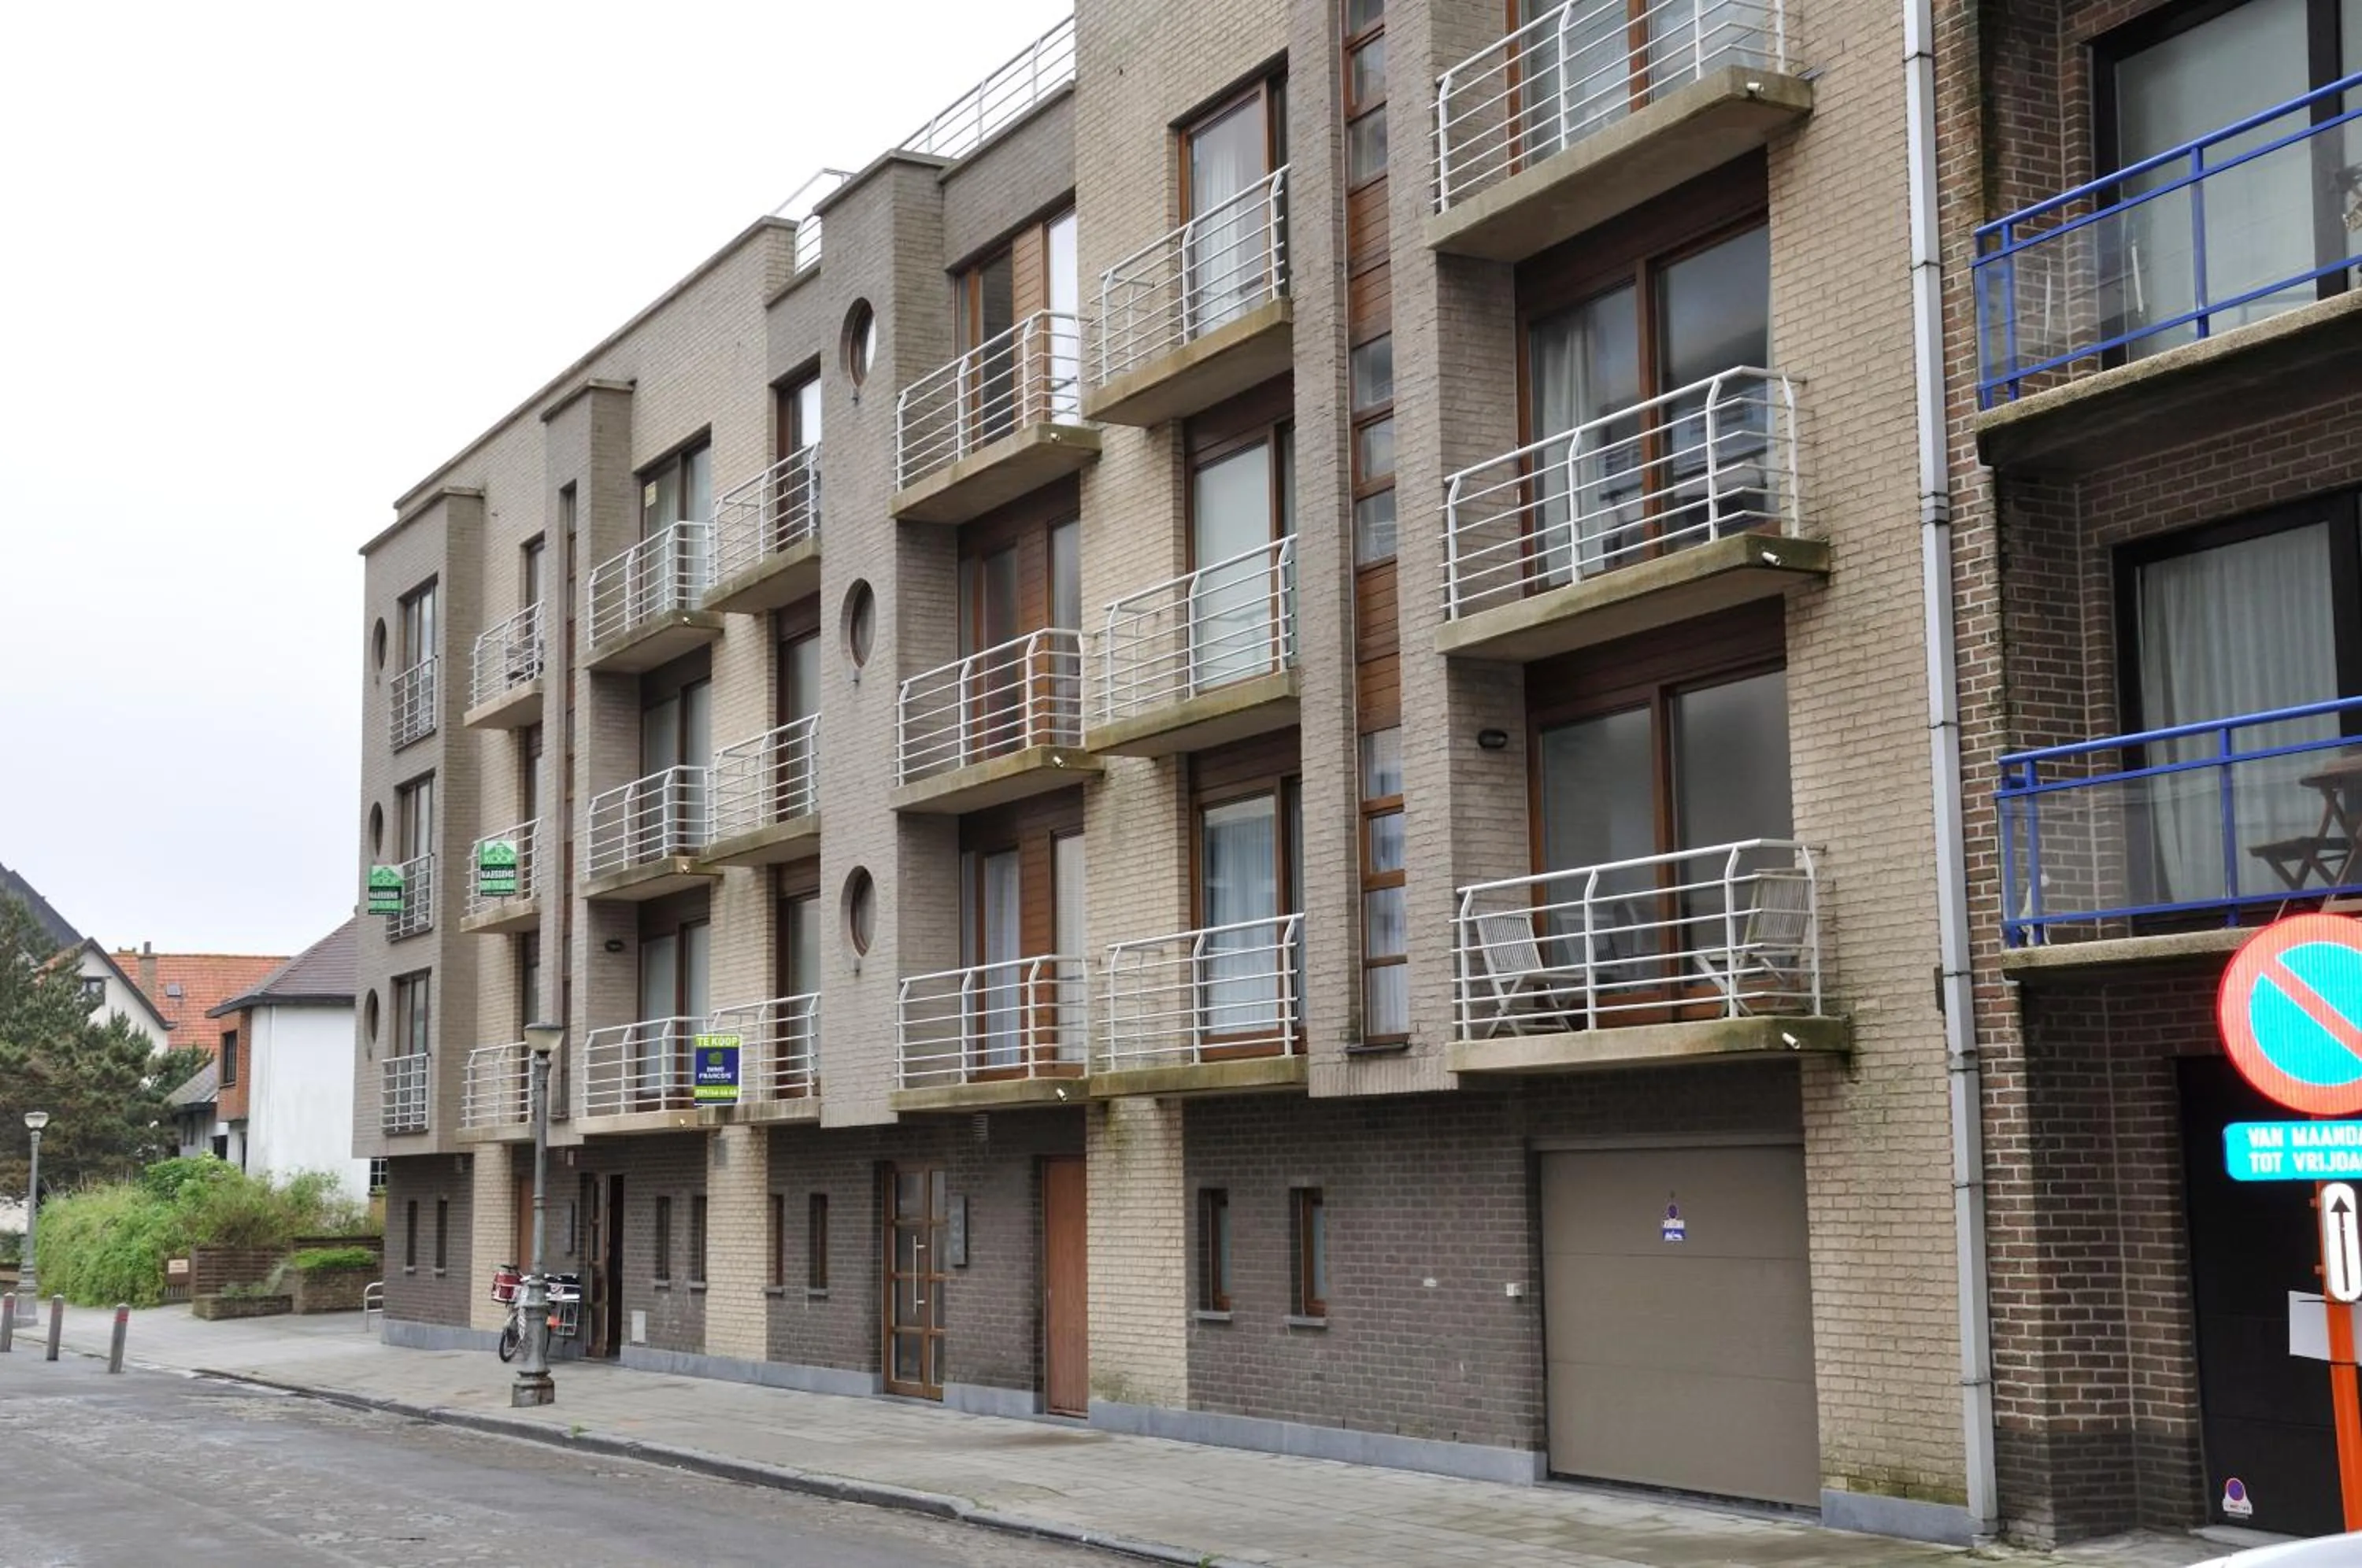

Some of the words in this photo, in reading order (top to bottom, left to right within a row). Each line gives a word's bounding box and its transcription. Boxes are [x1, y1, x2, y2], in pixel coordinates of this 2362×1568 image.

[483, 855, 512, 864] KOOP
[698, 1037, 709, 1046] TE
[711, 1037, 738, 1046] KOOP
[2248, 1126, 2283, 1148] VAN
[2249, 1152, 2282, 1173] TOT
